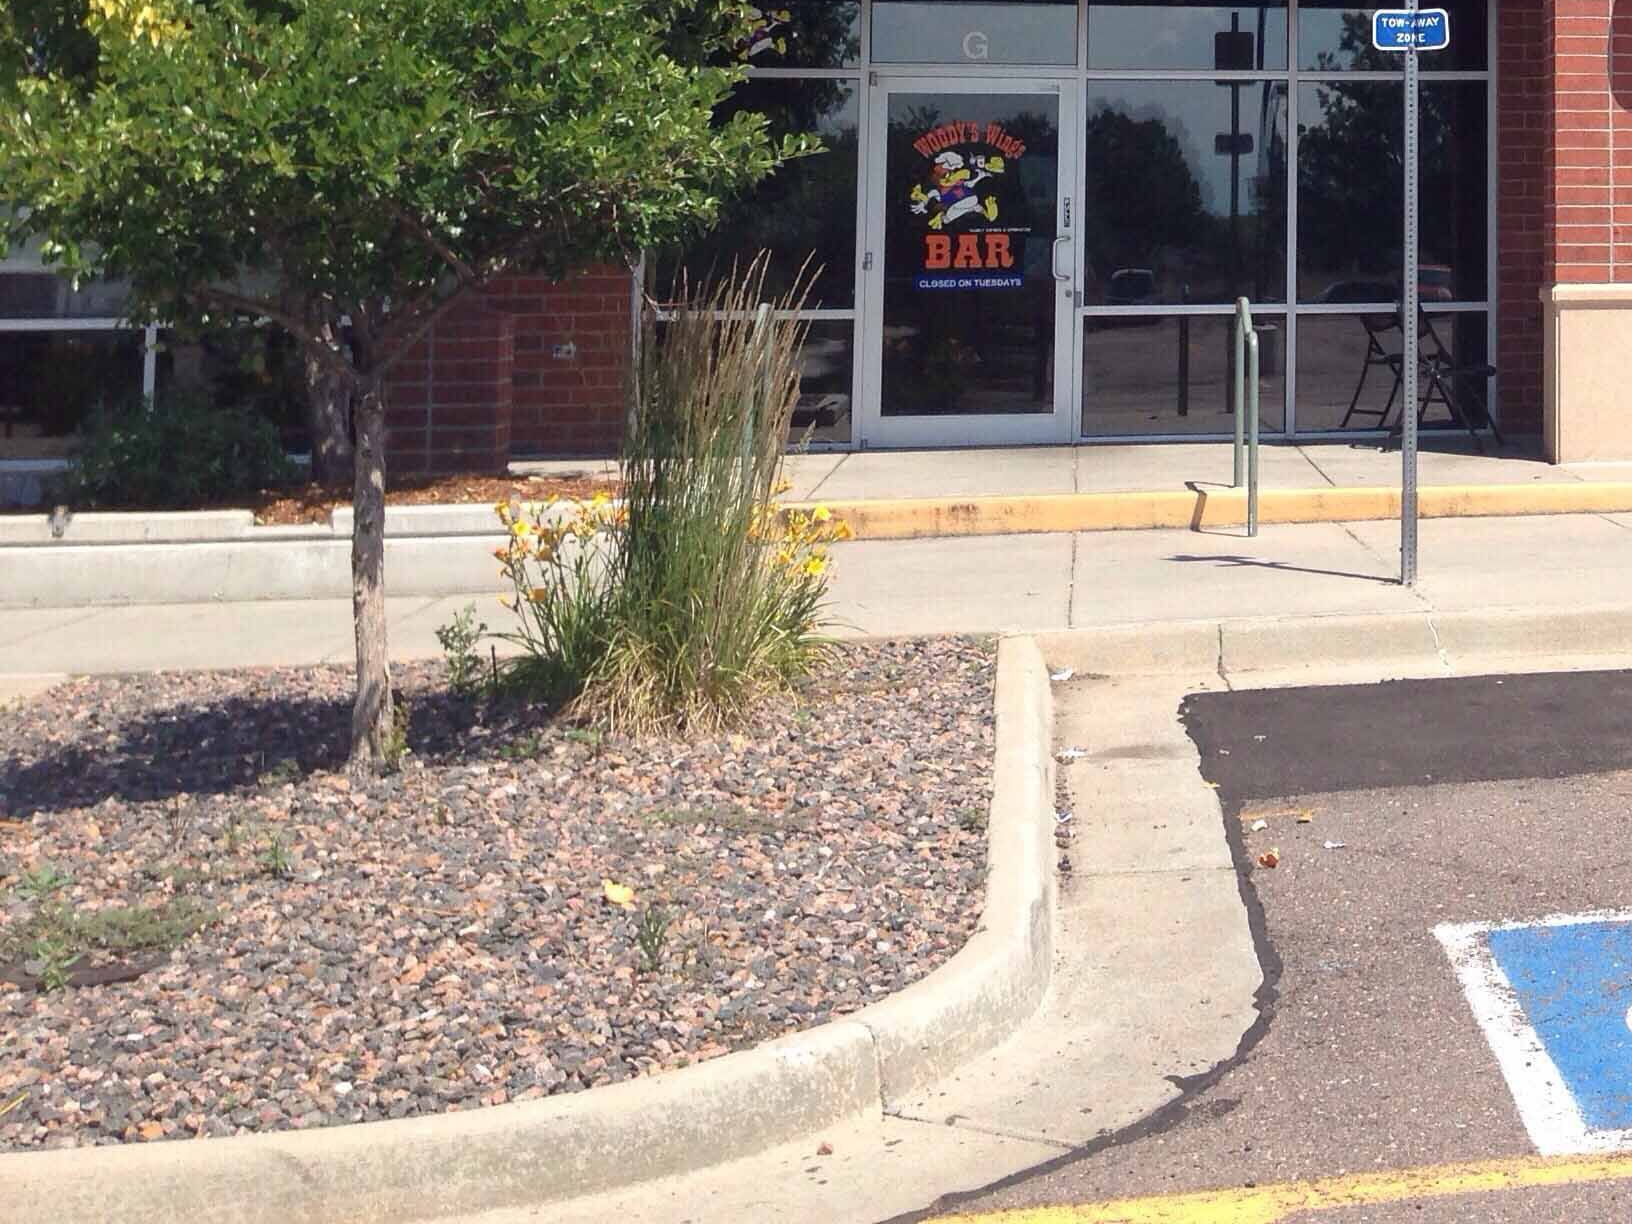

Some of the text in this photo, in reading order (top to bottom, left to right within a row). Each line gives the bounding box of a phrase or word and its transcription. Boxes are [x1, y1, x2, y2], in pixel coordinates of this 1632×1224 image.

[1381, 16, 1440, 28] TOW-AWAY
[1396, 32, 1426, 43] ZONE
[962, 31, 989, 60] G
[925, 234, 1014, 269] BAR
[919, 278, 1022, 288] CLOSED ON TUESDAYS
